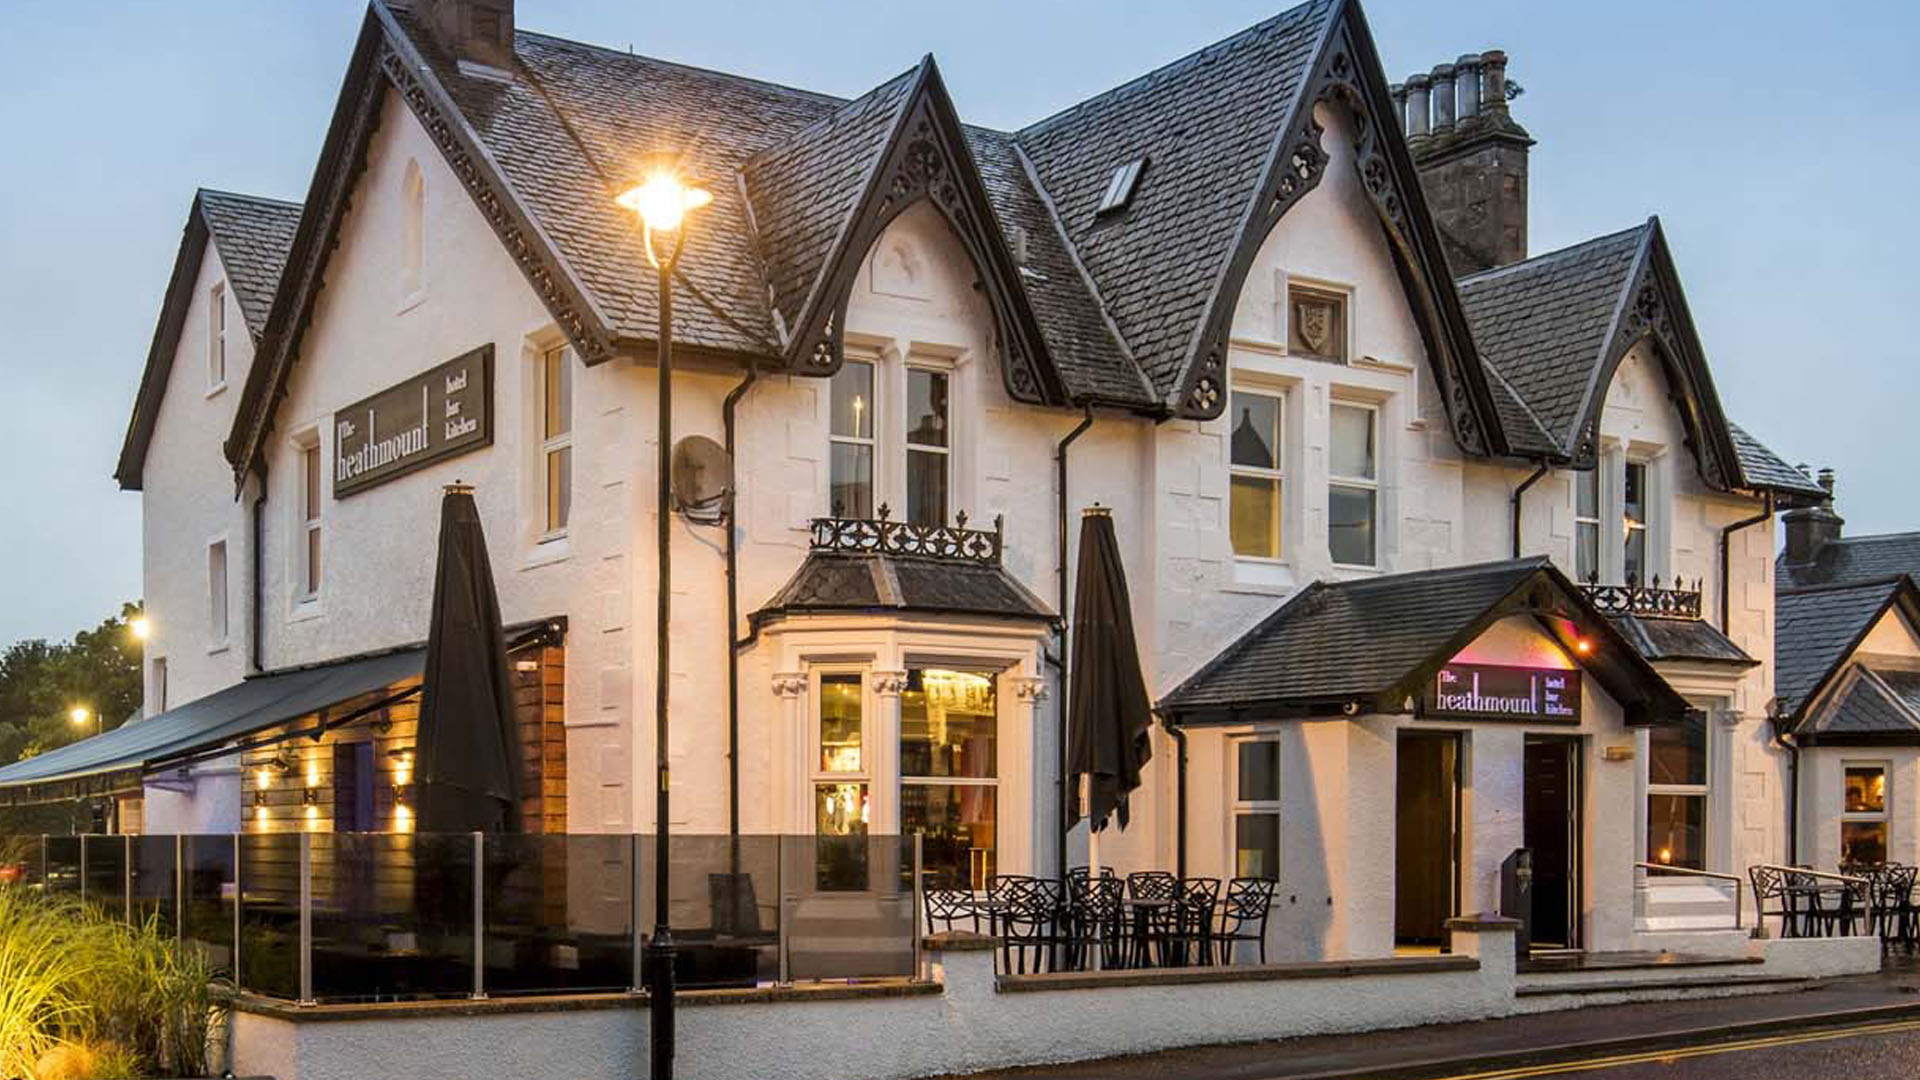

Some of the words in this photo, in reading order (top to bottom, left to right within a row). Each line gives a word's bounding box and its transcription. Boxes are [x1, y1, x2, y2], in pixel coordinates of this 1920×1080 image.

[446, 369, 467, 394] hotel
[445, 399, 461, 418] bar
[337, 385, 429, 481] heathmount
[339, 420, 355, 438] The
[445, 417, 477, 441] kitchen
[1438, 670, 1457, 683] The
[1545, 677, 1565, 689] hotel
[1437, 672, 1537, 714] heathmount
[1545, 689, 1559, 702] bar
[1545, 703, 1573, 715] kitchen
